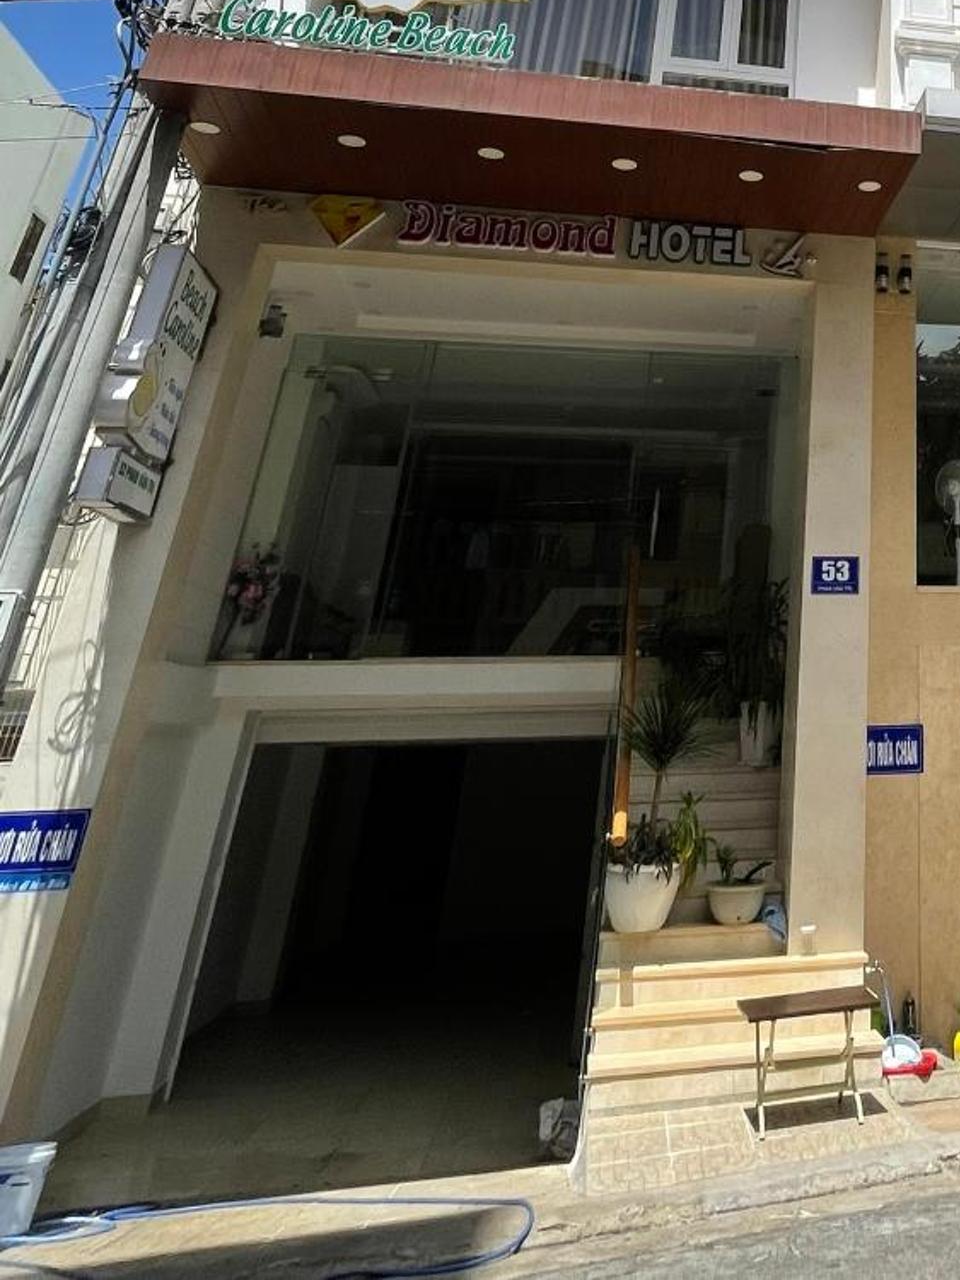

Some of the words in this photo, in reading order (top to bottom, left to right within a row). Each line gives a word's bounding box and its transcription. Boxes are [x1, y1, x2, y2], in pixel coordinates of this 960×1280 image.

[397, 10, 517, 61] Beach
[398, 199, 618, 258] Diamond
[629, 221, 751, 265] HOTEL
[822, 561, 850, 581] 53
